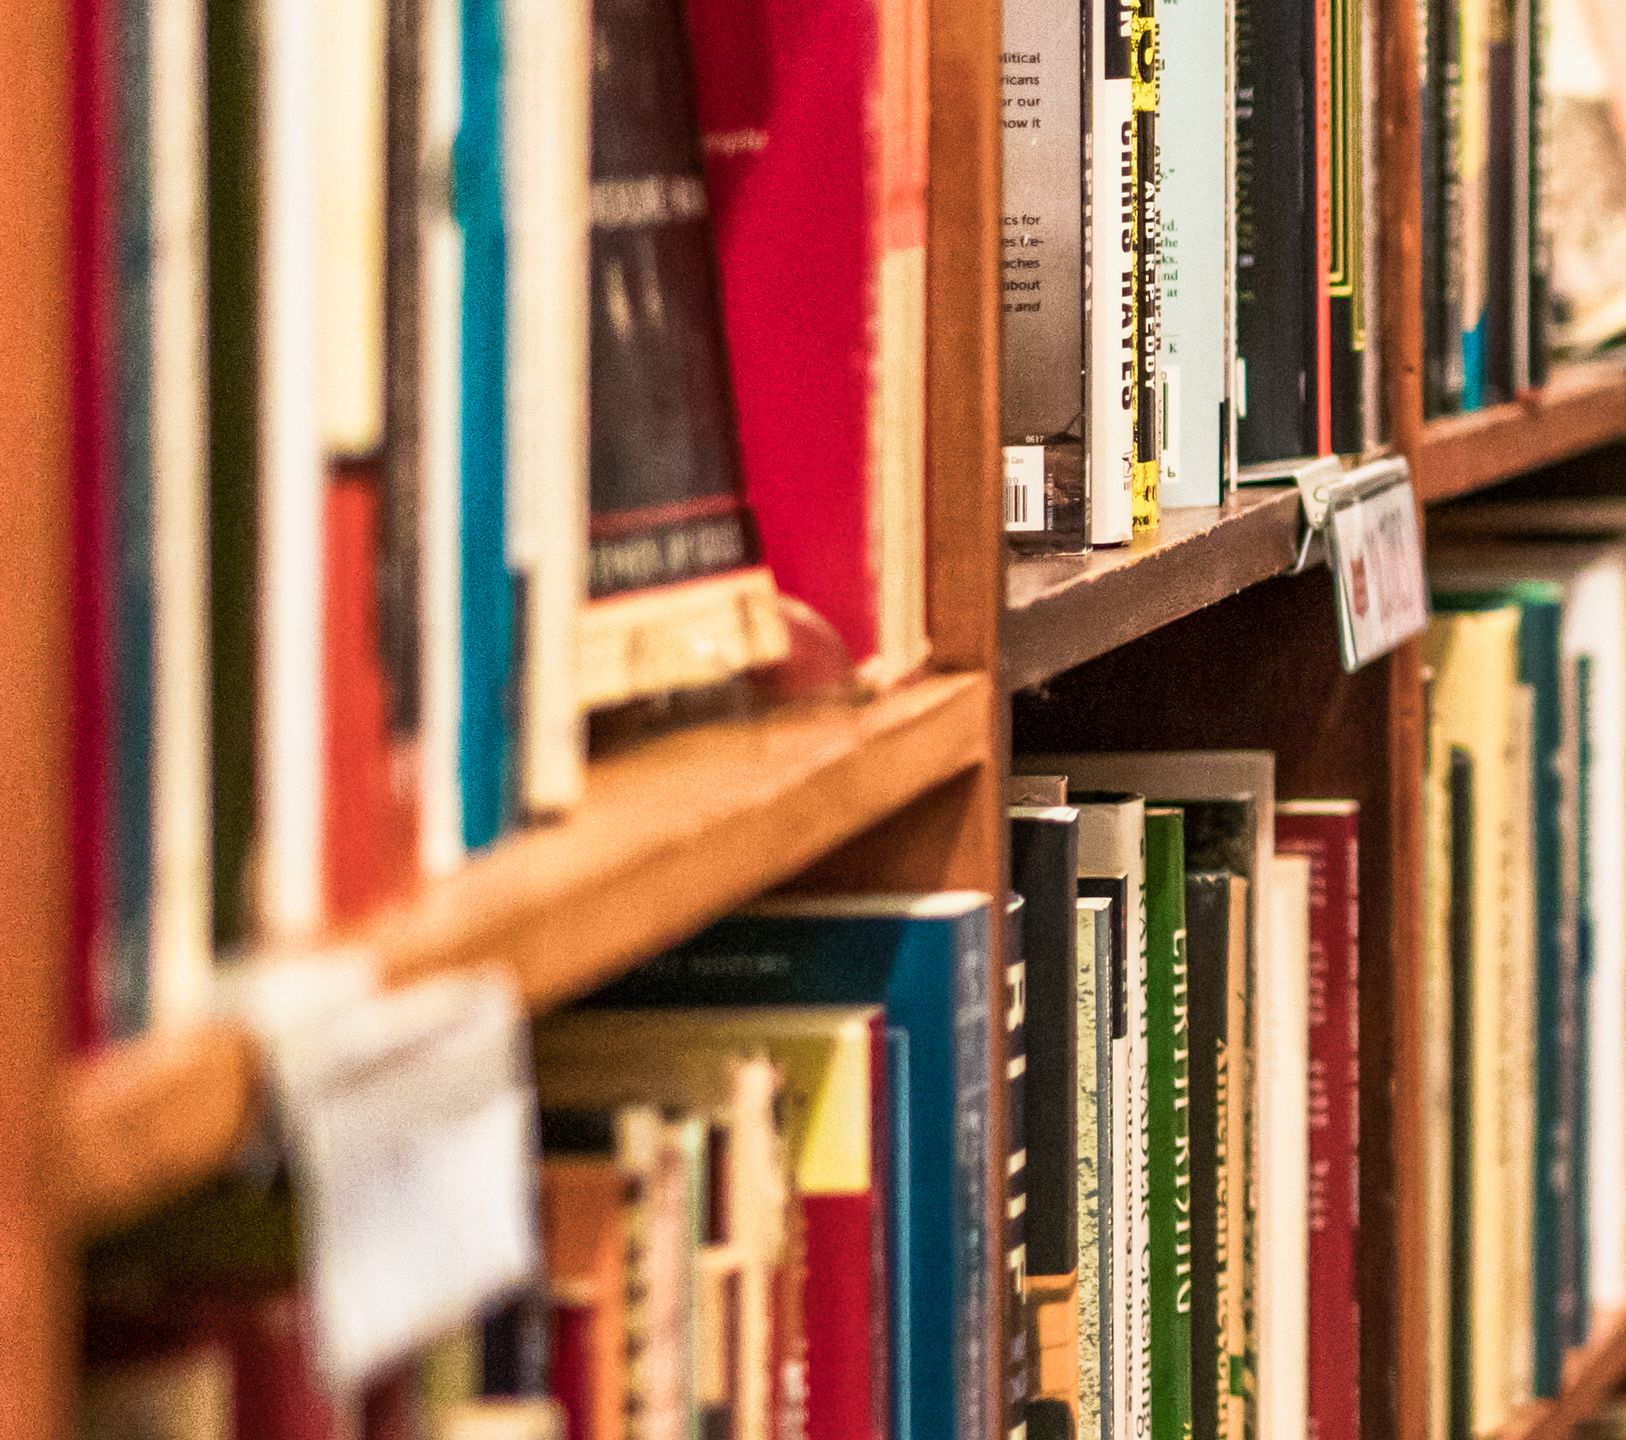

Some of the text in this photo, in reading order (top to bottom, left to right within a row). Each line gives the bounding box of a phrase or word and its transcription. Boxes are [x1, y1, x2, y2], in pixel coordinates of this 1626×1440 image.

[1017, 97, 1041, 107] our
[1021, 213, 1041, 226] for
[1145, 180, 1157, 239] AND
[1121, 120, 1135, 411] CHRIS HAYES
[1016, 300, 1041, 312] and
[1145, 316, 1157, 391] EDDY
